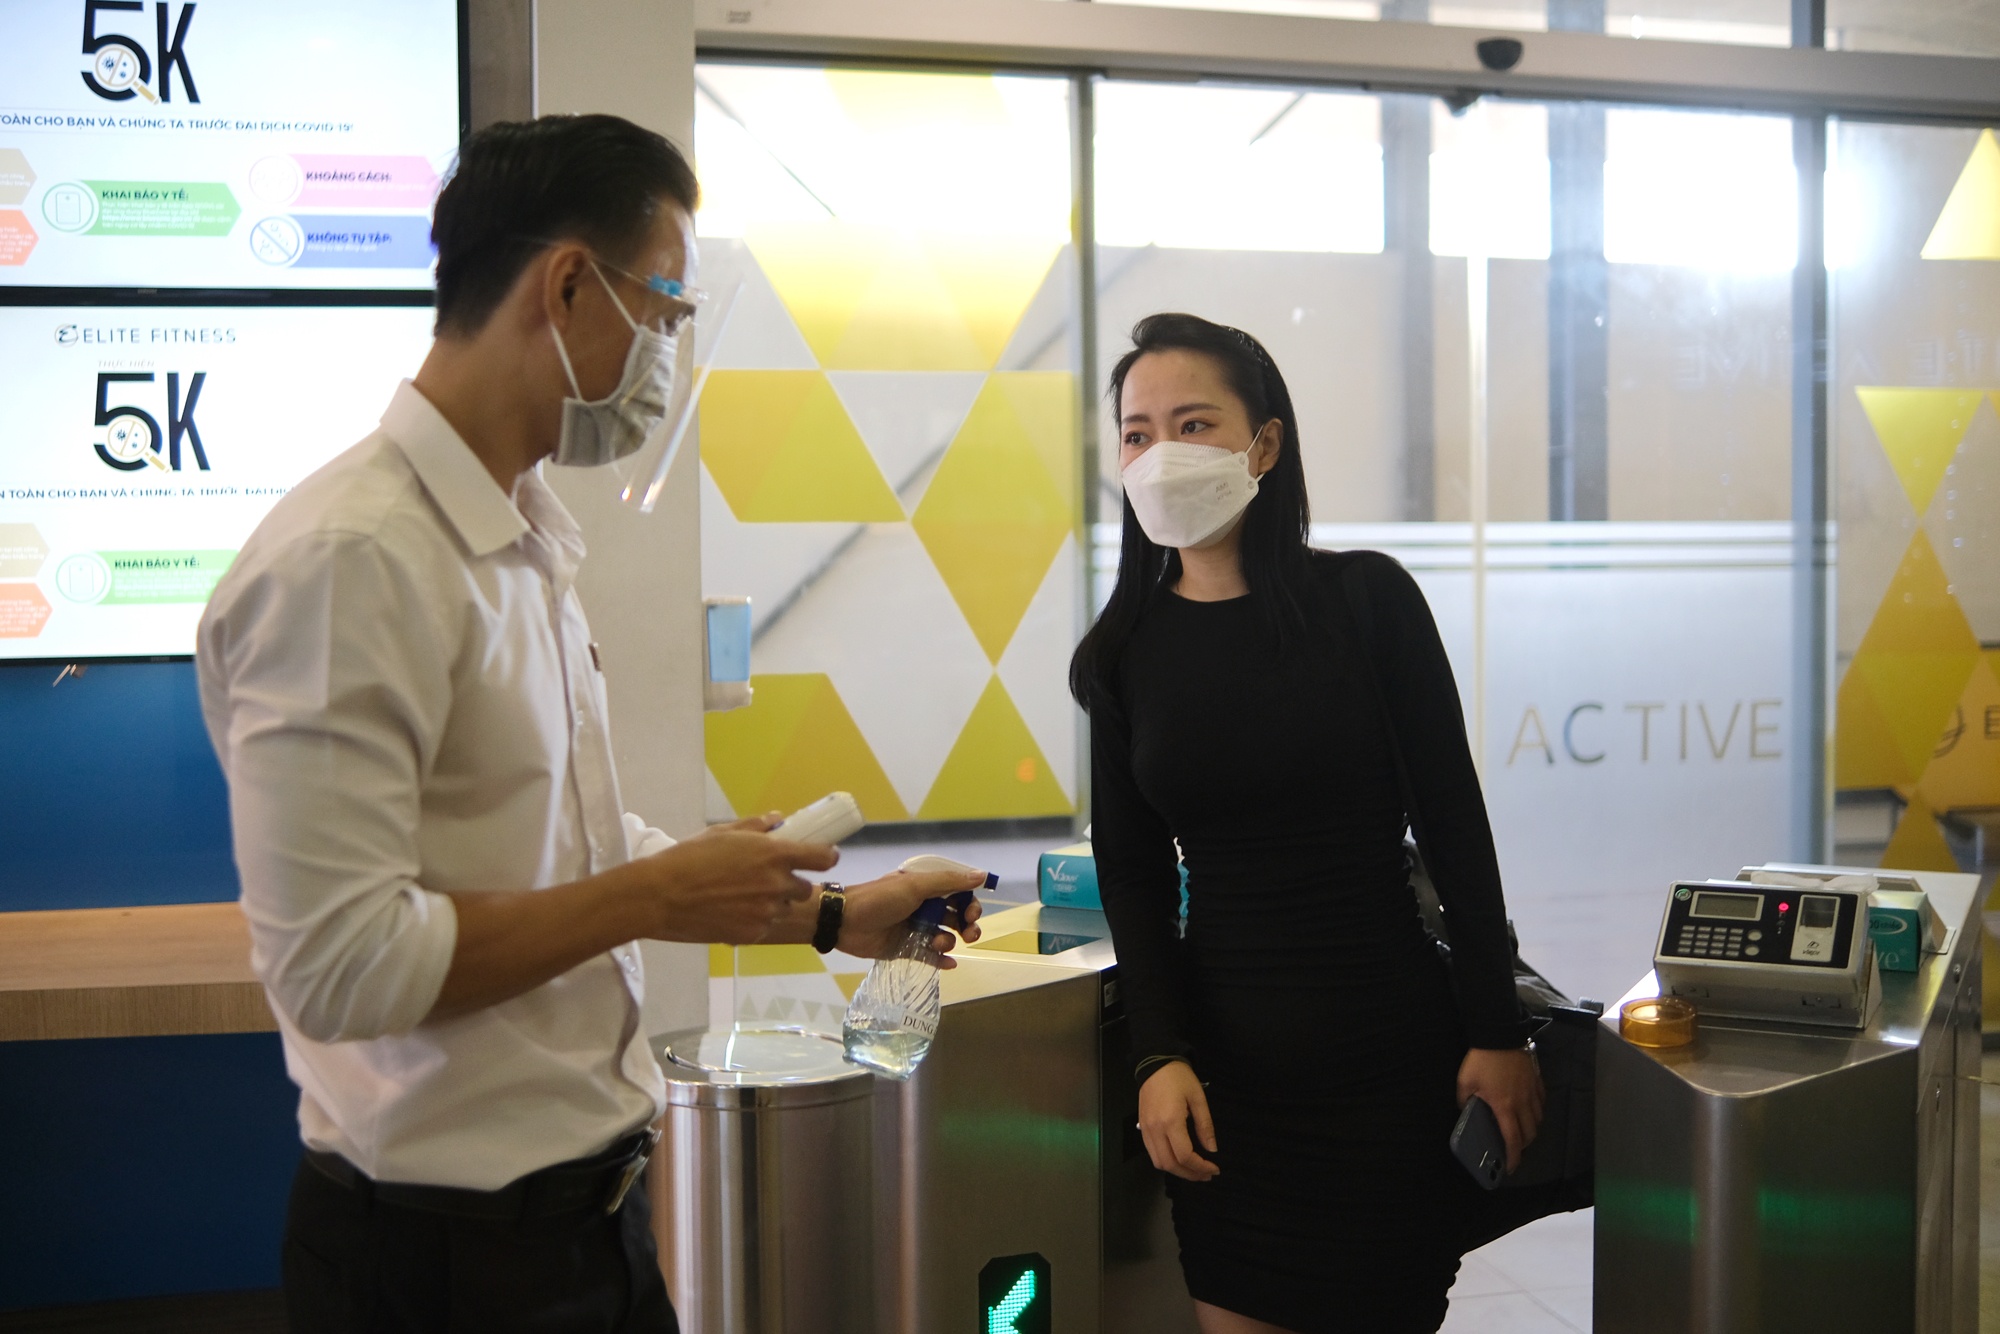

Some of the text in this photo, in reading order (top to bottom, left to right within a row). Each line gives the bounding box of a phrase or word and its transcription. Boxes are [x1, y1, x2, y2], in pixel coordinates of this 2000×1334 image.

[81, 0, 201, 104] 5K
[0, 113, 31, 126] OÀN
[34, 116, 64, 126] CHO
[67, 117, 95, 130] BẠN
[98, 115, 116, 127] VÀ
[169, 119, 184, 129] TA
[102, 190, 131, 200] KHAI
[134, 188, 159, 200] BÁO
[161, 191, 169, 200] Y
[83, 328, 237, 344] ELITE FITNESS
[93, 371, 211, 473] 5K
[9, 487, 45, 499] TOÀN
[48, 489, 76, 499] CHO
[115, 559, 143, 569] KHAI
[173, 559, 180, 567] Y
[1507, 699, 1785, 766] ACTIVE
[903, 1015, 935, 1035] DUNG
